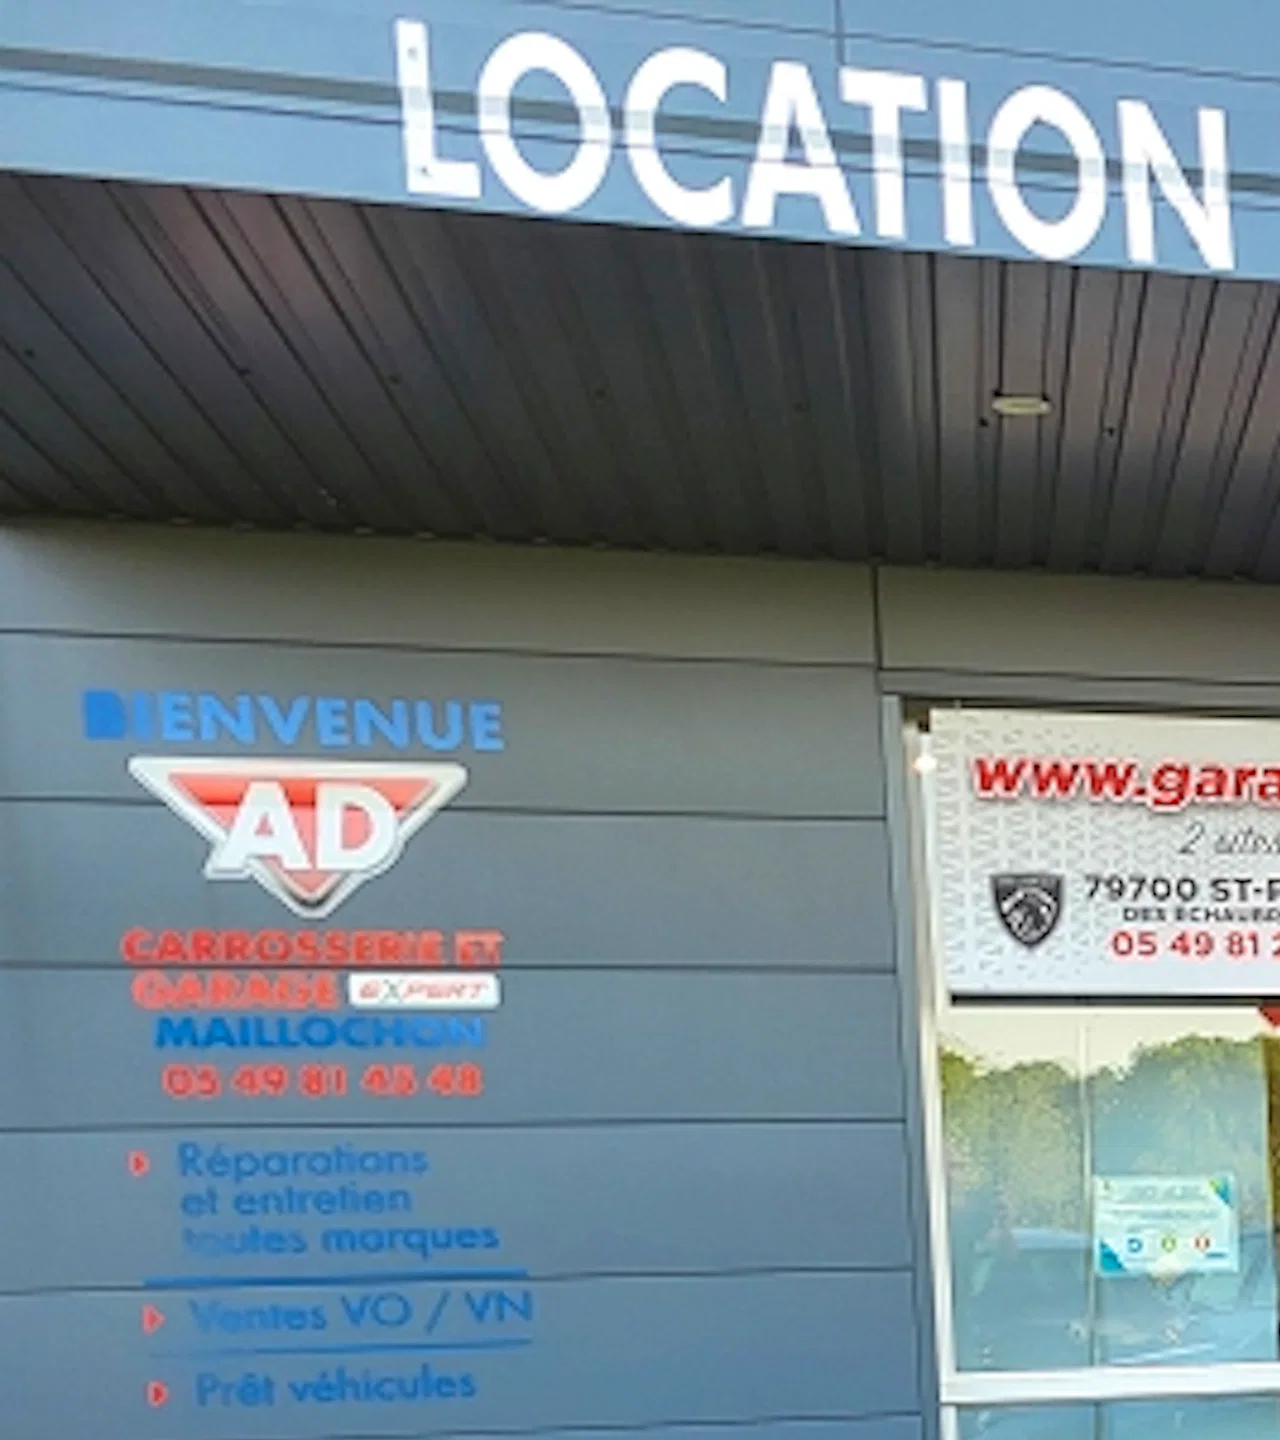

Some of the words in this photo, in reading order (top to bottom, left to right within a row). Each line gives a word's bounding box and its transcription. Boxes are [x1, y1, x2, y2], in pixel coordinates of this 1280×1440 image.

[394, 18, 1236, 272] LOCATION
[82, 689, 505, 752] BIENVENUE
[214, 780, 402, 873] AD
[1178, 820, 1206, 855] 2
[1084, 876, 1198, 903] 79700
[120, 927, 446, 966] CARROSSERIE
[454, 930, 505, 967] ET
[1110, 929, 1158, 958] 05
[1169, 930, 1215, 958] 49
[1225, 930, 1260, 958] 81
[131, 969, 341, 1010] GARAGE
[154, 1015, 486, 1050] MAILLOCHON
[231, 1065, 290, 1098] 49
[299, 1065, 347, 1097] 81
[426, 1062, 484, 1097] 48
[176, 1141, 430, 1184] Réparations
[180, 1187, 219, 1218] et
[231, 1182, 414, 1217] entretien
[182, 1225, 308, 1256] toutes
[320, 1225, 500, 1261] marques
[187, 1298, 328, 1334] Ventes
[339, 1293, 412, 1328] VO
[423, 1290, 452, 1335] /
[463, 1290, 535, 1324] VN
[195, 1370, 275, 1408] Prêt
[287, 1362, 478, 1404] véhicules
